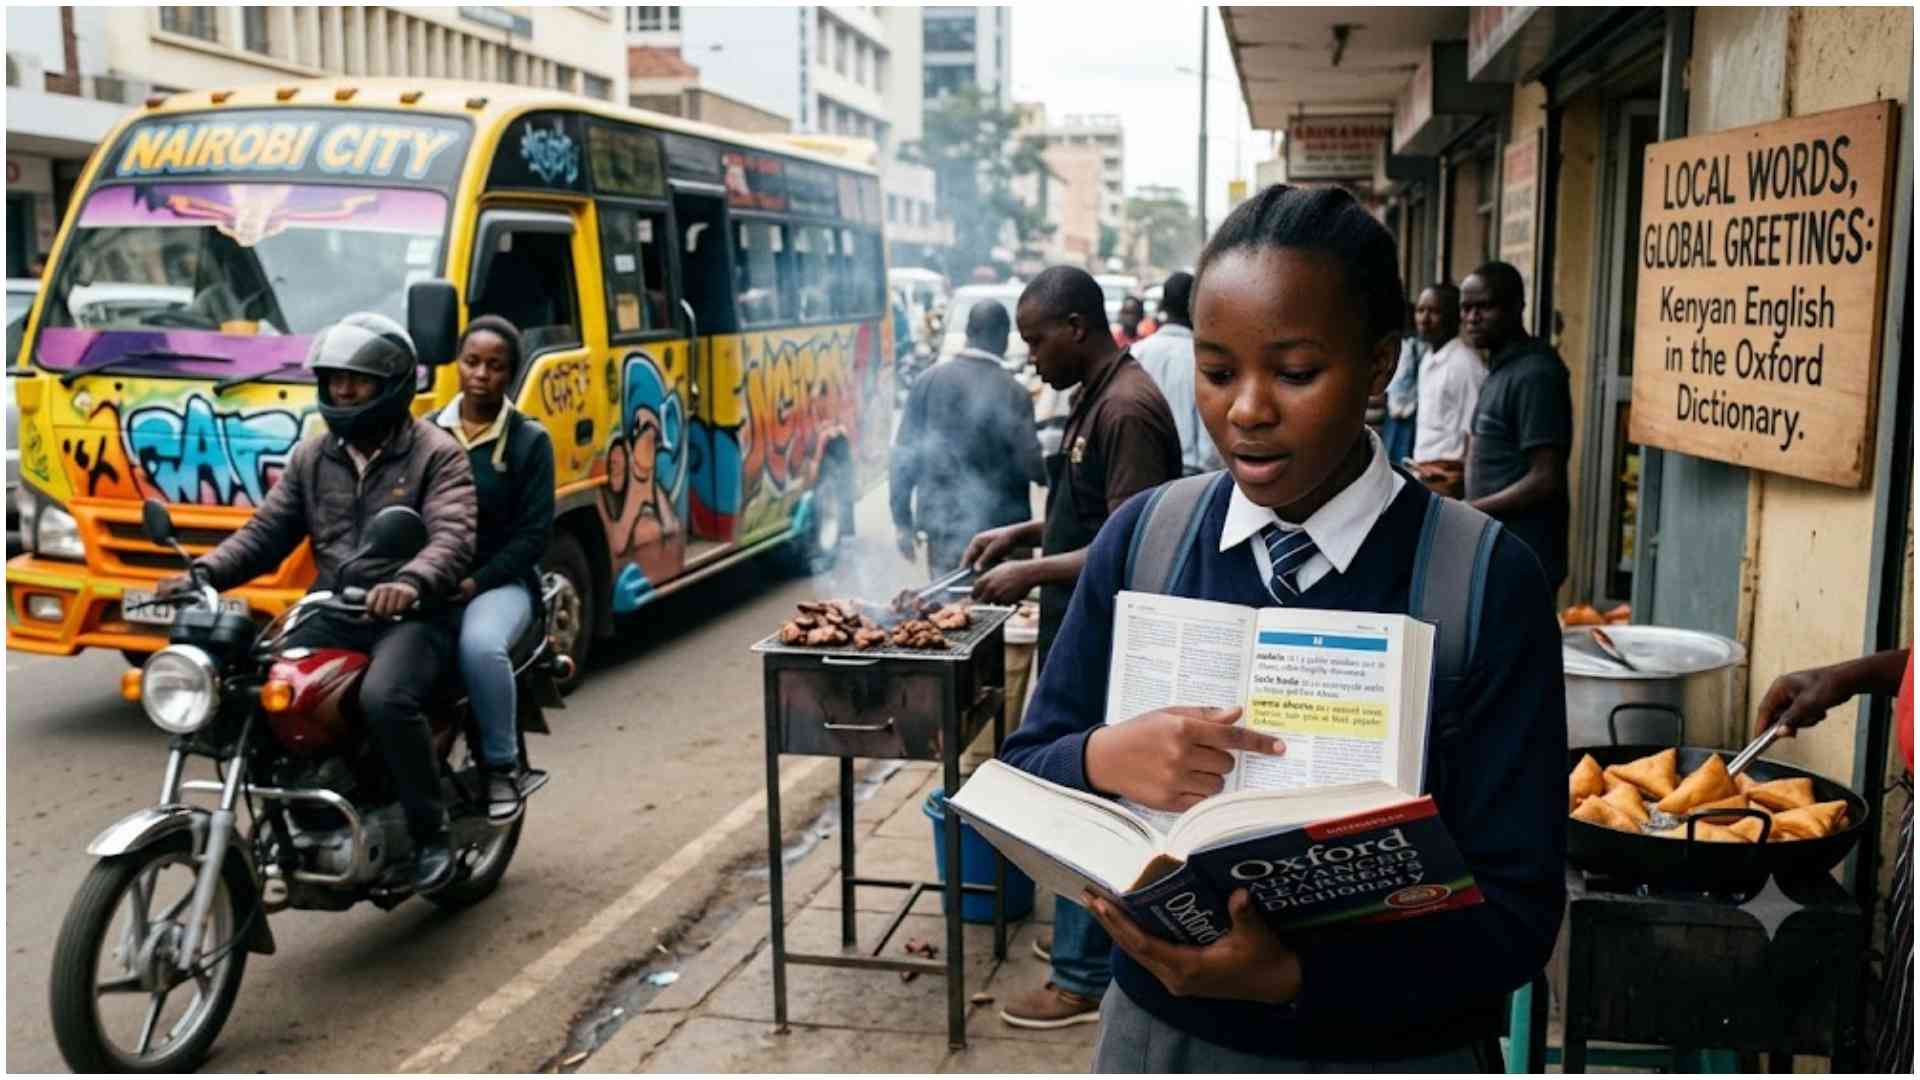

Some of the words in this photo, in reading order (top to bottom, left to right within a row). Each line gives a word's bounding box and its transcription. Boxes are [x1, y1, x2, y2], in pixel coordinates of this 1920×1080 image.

[117, 121, 319, 177] NAIROBI
[316, 122, 459, 181] CITY
[1663, 154, 1735, 210] LOCAL
[1747, 134, 1858, 201] WORDS,
[1643, 219, 1717, 270] GLOBAL
[1723, 207, 1875, 268] GREETINGS:
[1660, 286, 1736, 333] Kenyan
[1745, 285, 1836, 340] English
[1665, 336, 1683, 373] in
[1691, 338, 1726, 376] the
[1735, 338, 1823, 386] Oxford
[1676, 383, 1805, 451] Dictionary.
[1230, 828, 1412, 880] Oxford
[1250, 850, 1418, 891] ADVANCED
[1165, 892, 1231, 943] Oxford
[1264, 871, 1425, 911] Dictionary
